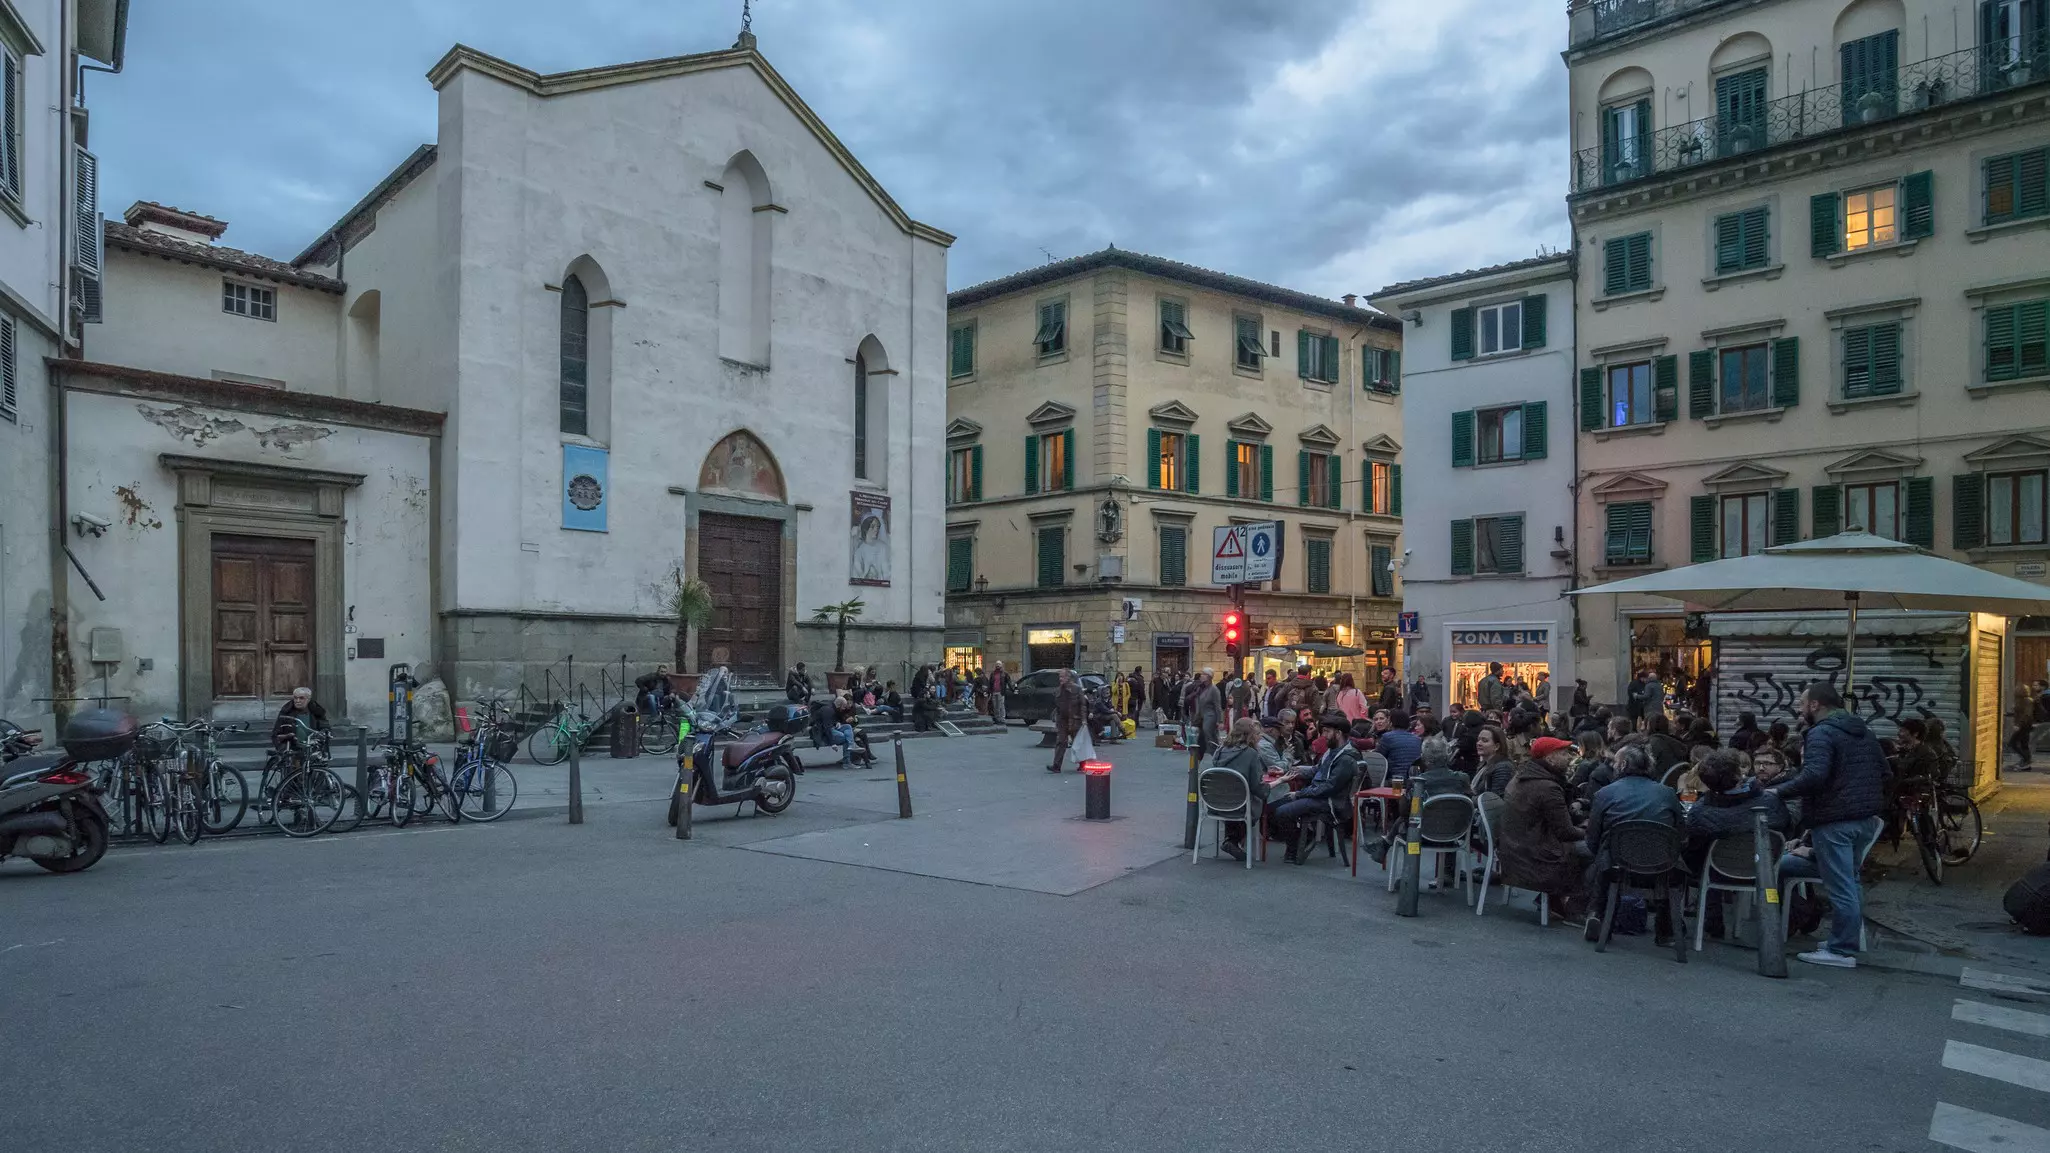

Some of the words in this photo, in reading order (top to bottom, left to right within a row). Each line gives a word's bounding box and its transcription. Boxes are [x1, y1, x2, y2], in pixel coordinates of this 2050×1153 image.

[1235, 526, 1246, 537] 12
[1453, 631, 1503, 645] ZONA
[1513, 631, 1548, 645] BLU
